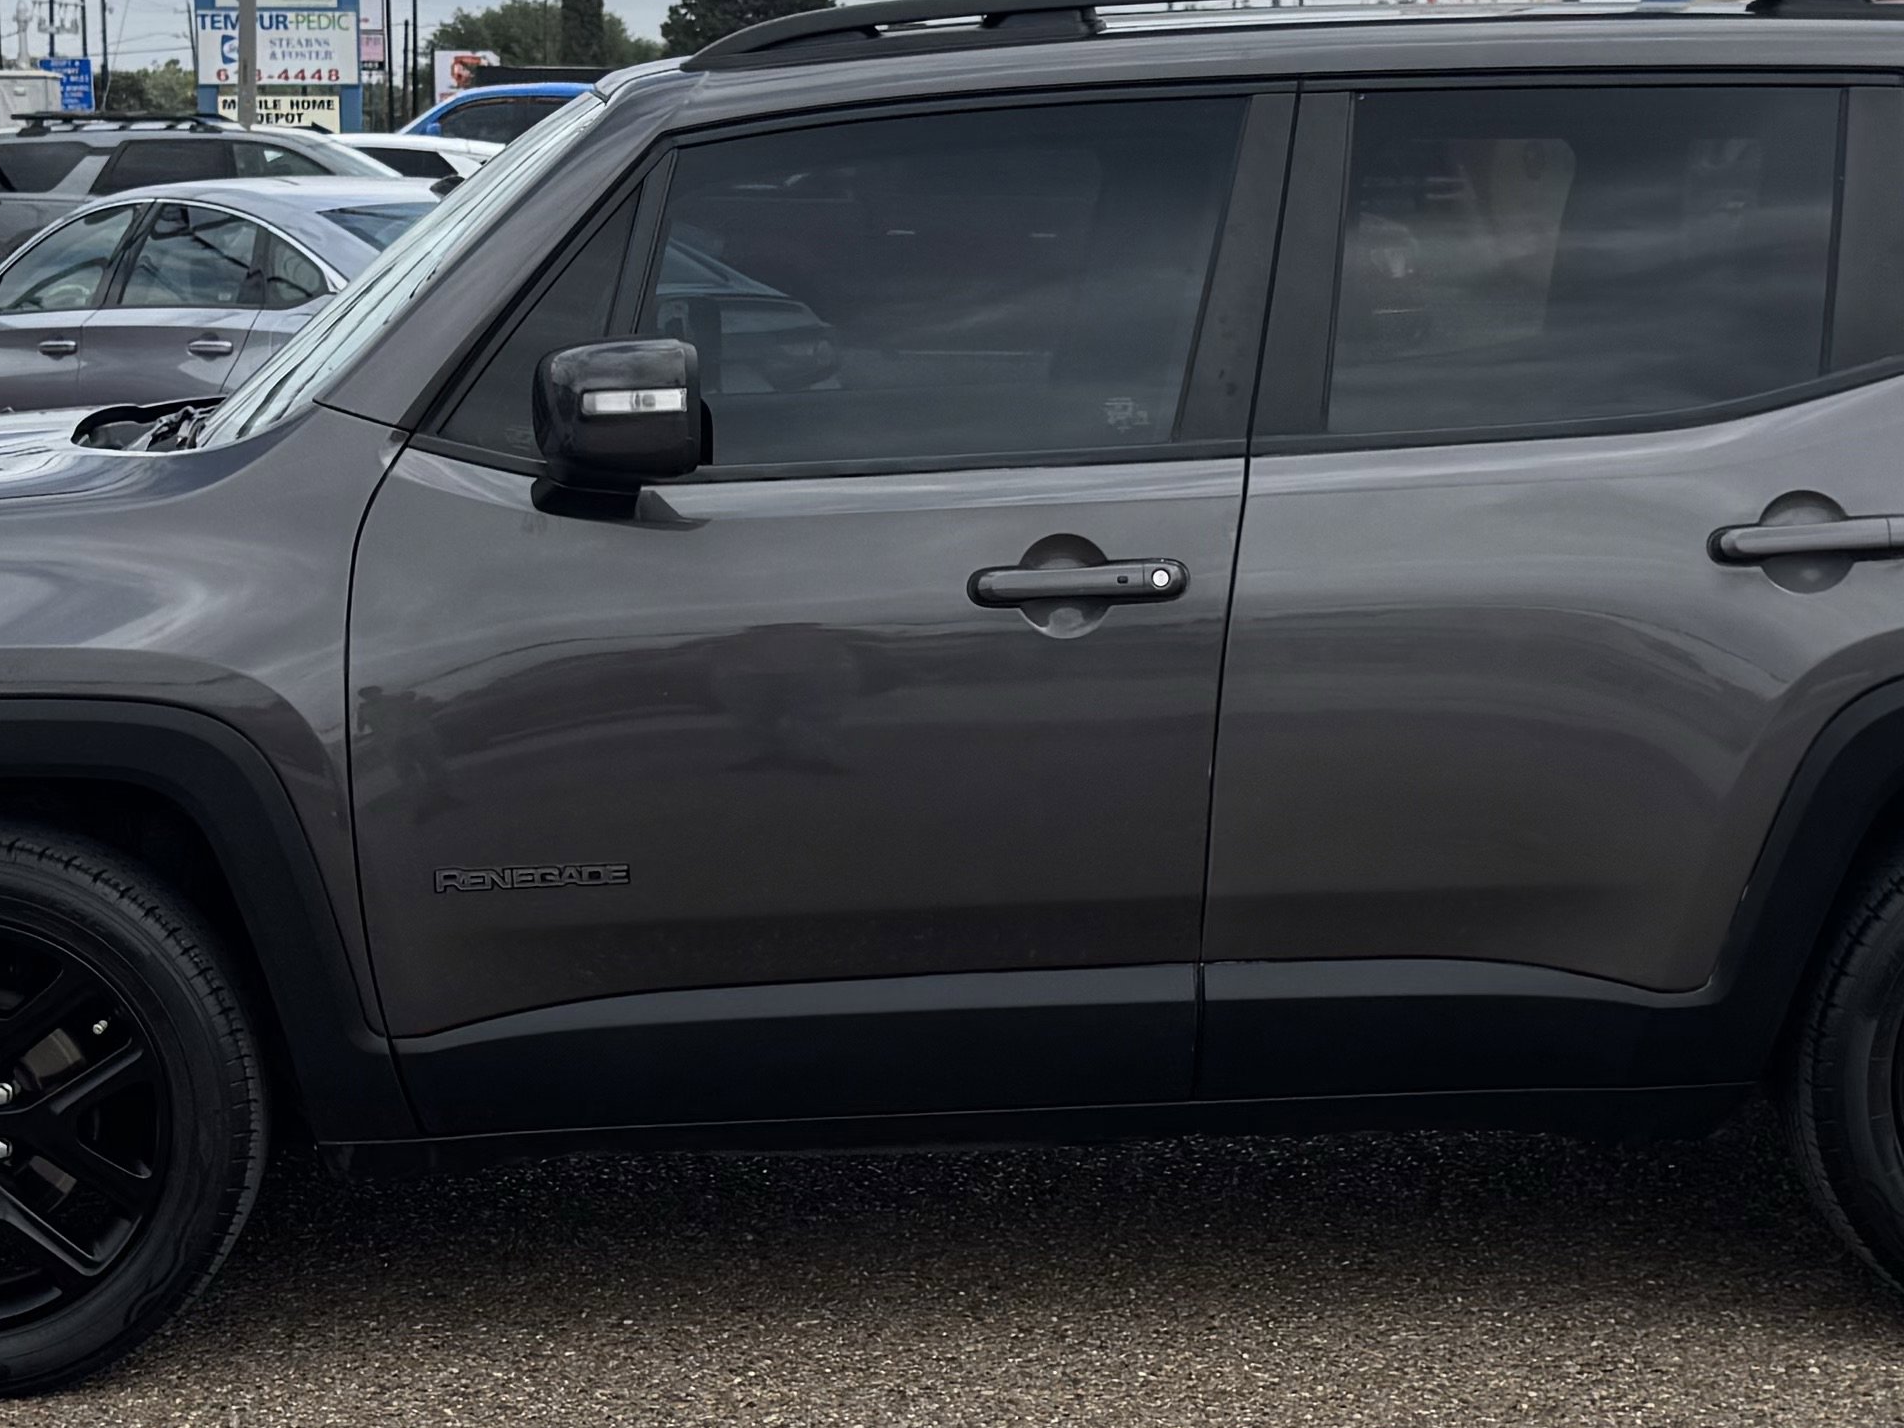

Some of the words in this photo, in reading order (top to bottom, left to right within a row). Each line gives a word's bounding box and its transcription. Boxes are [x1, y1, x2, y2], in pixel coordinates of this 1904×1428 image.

[197, 13, 350, 31] TEMUR-PEDIC
[269, 37, 331, 48] STEARNS
[269, 51, 277, 61] &
[280, 51, 333, 61] FOSTER
[216, 68, 340, 82] 6-4448
[222, 98, 282, 111] MILE
[289, 98, 335, 111] HOME
[434, 862, 631, 893] RENEGADE
